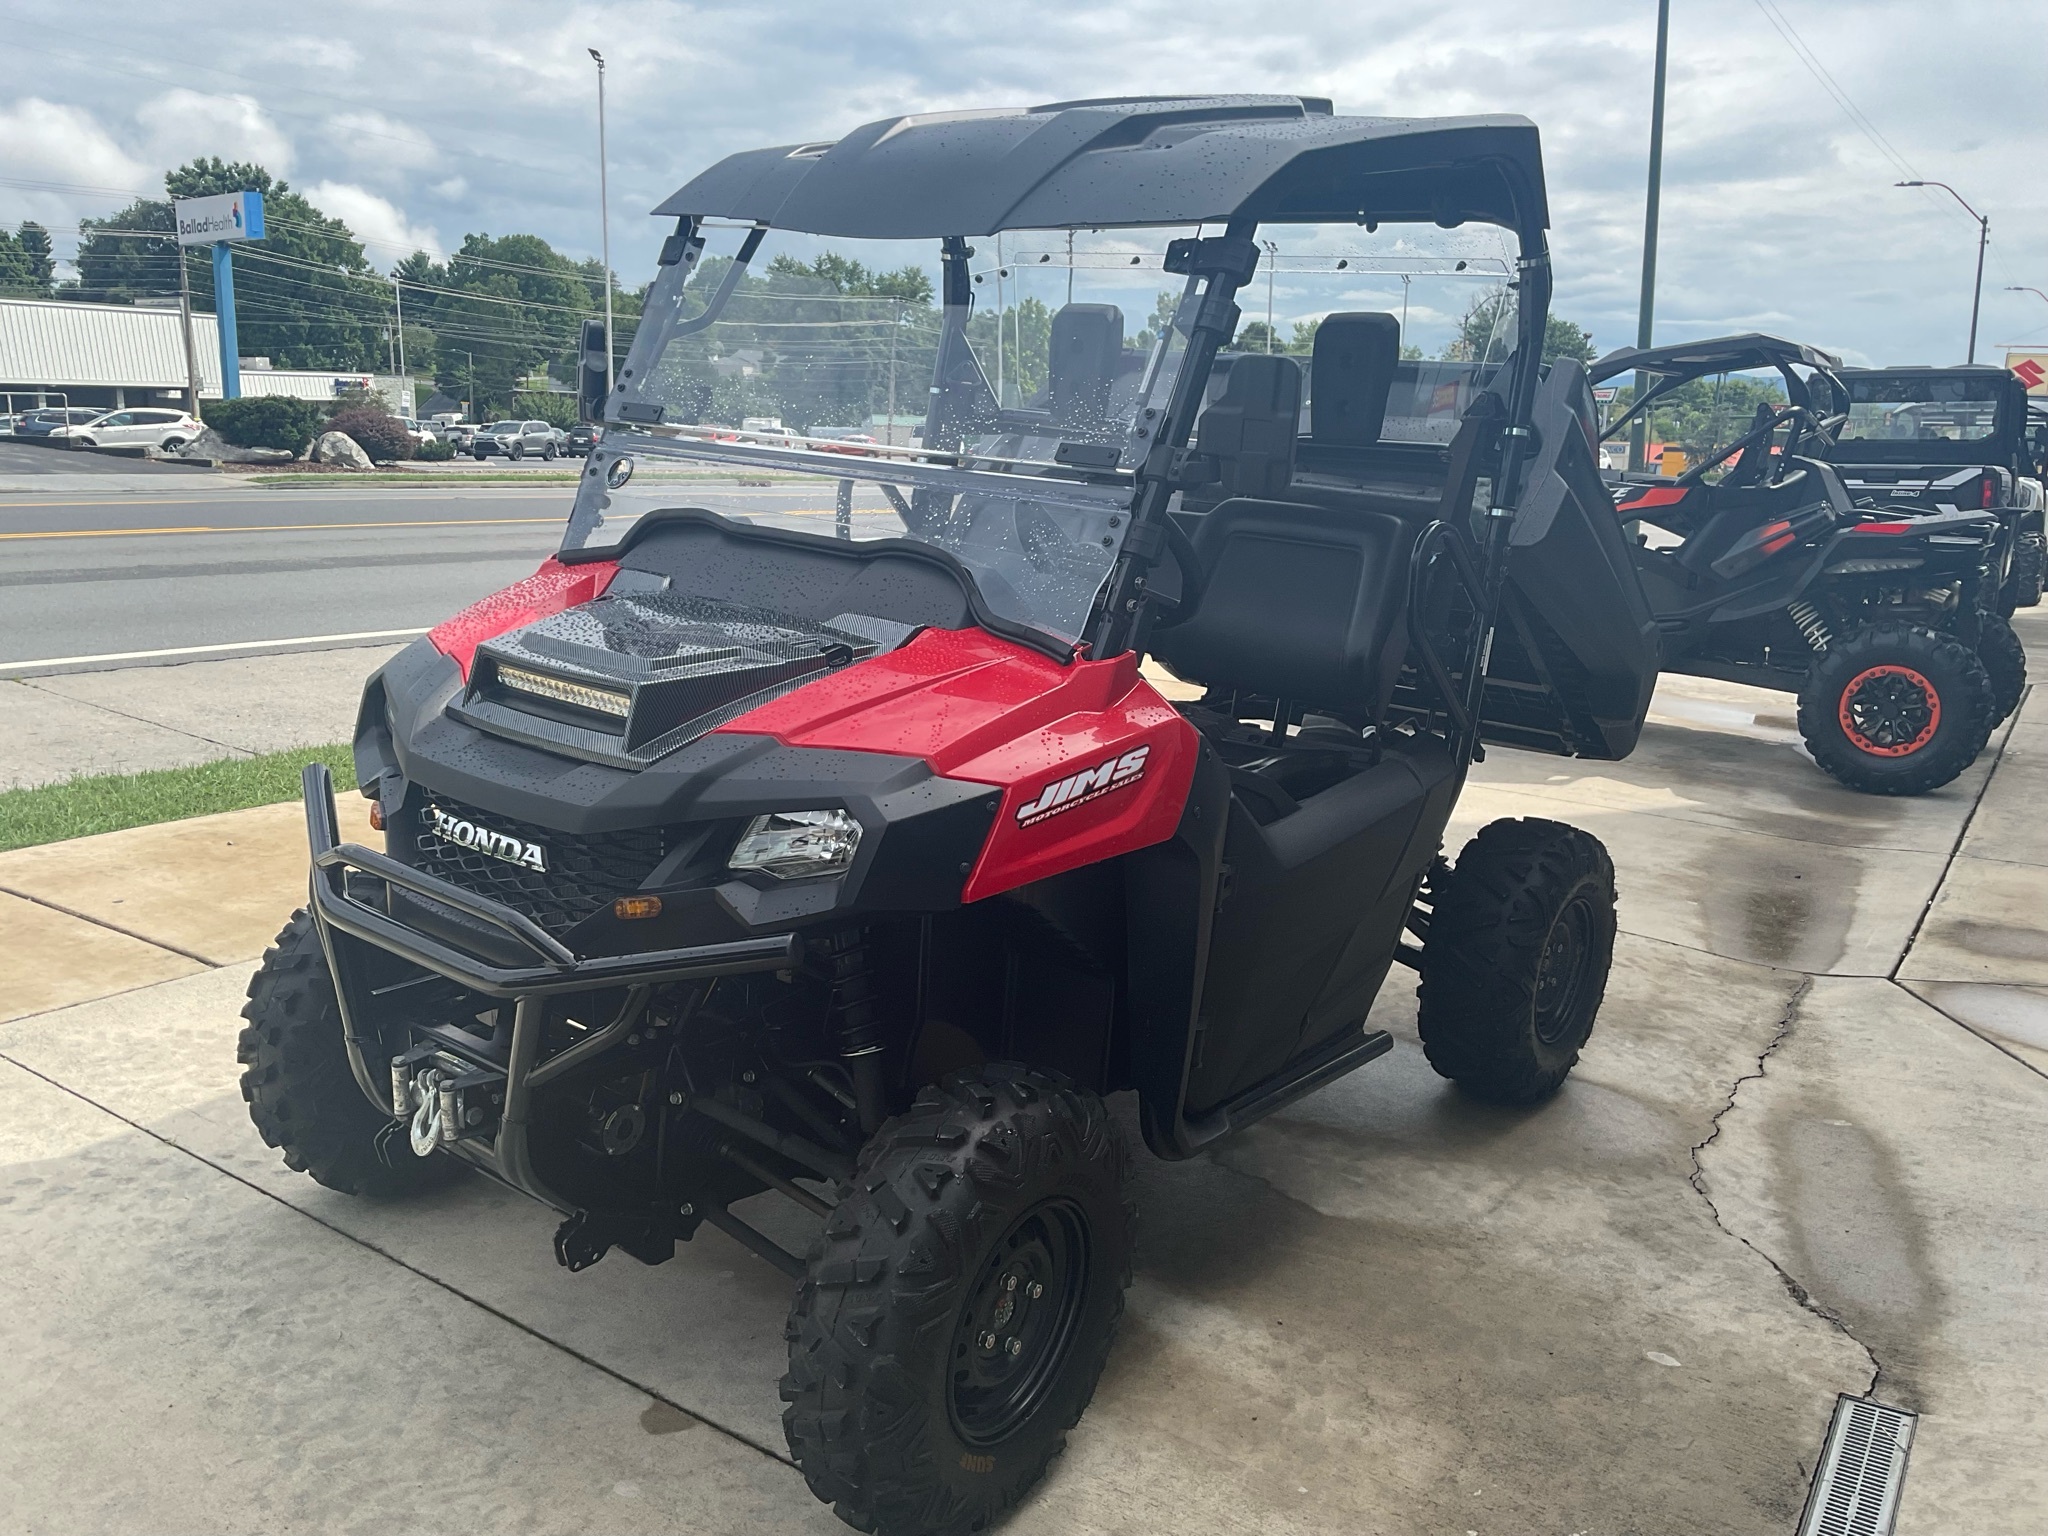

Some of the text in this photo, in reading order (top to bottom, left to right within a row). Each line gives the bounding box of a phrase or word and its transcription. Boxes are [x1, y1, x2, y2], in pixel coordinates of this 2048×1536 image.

[179, 214, 233, 235] BalladHealth
[1016, 745, 1150, 820] JIMS
[1020, 772, 1145, 828] MOTORCYCLE SALES
[431, 810, 547, 873] HONDA
